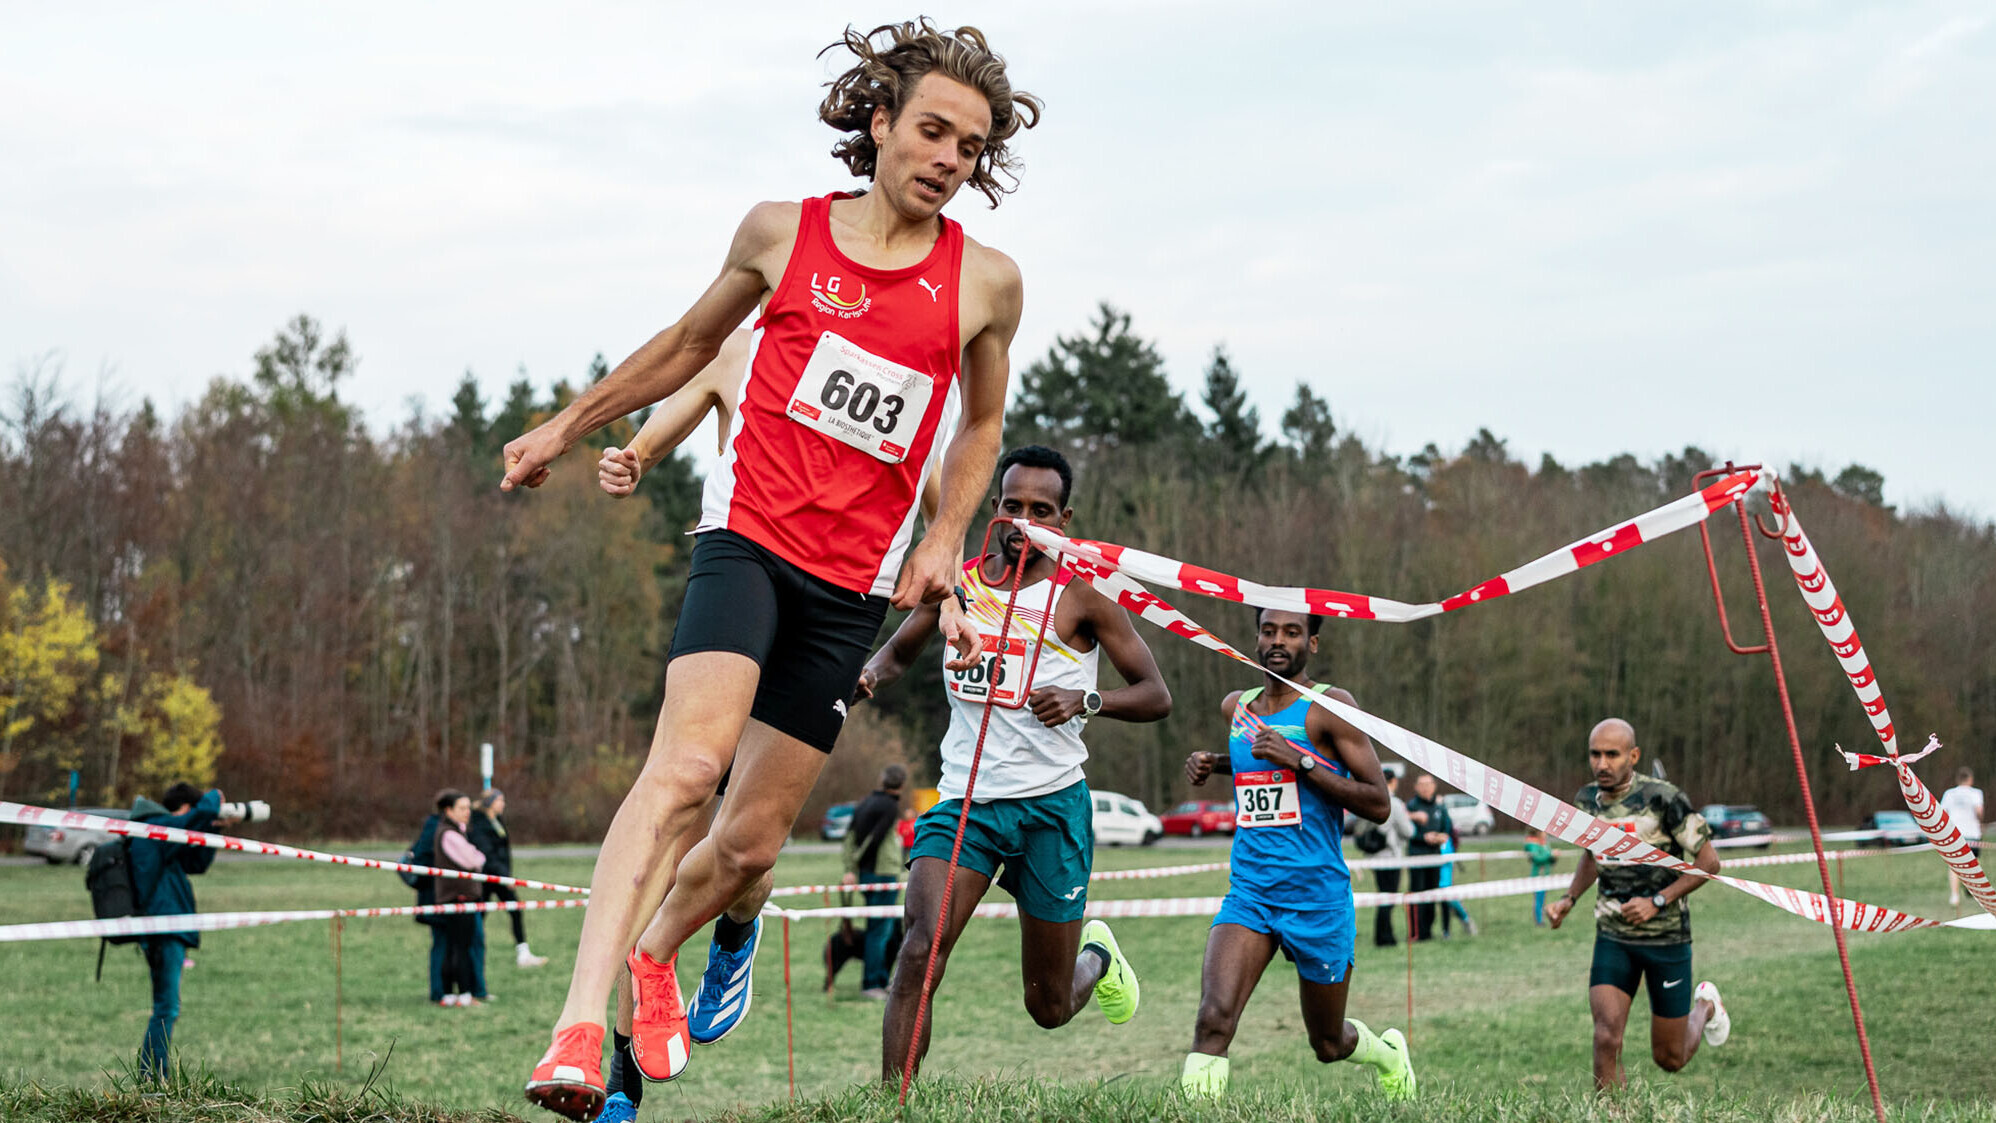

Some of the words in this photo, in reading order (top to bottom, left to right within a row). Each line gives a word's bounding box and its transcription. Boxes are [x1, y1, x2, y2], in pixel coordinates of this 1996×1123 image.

[811, 297, 836, 316] Region
[882, 366, 904, 381] Cross
[820, 369, 905, 435] 603
[828, 416, 835, 424] LA
[953, 652, 1007, 687] 66
[1243, 786, 1284, 813] 367
